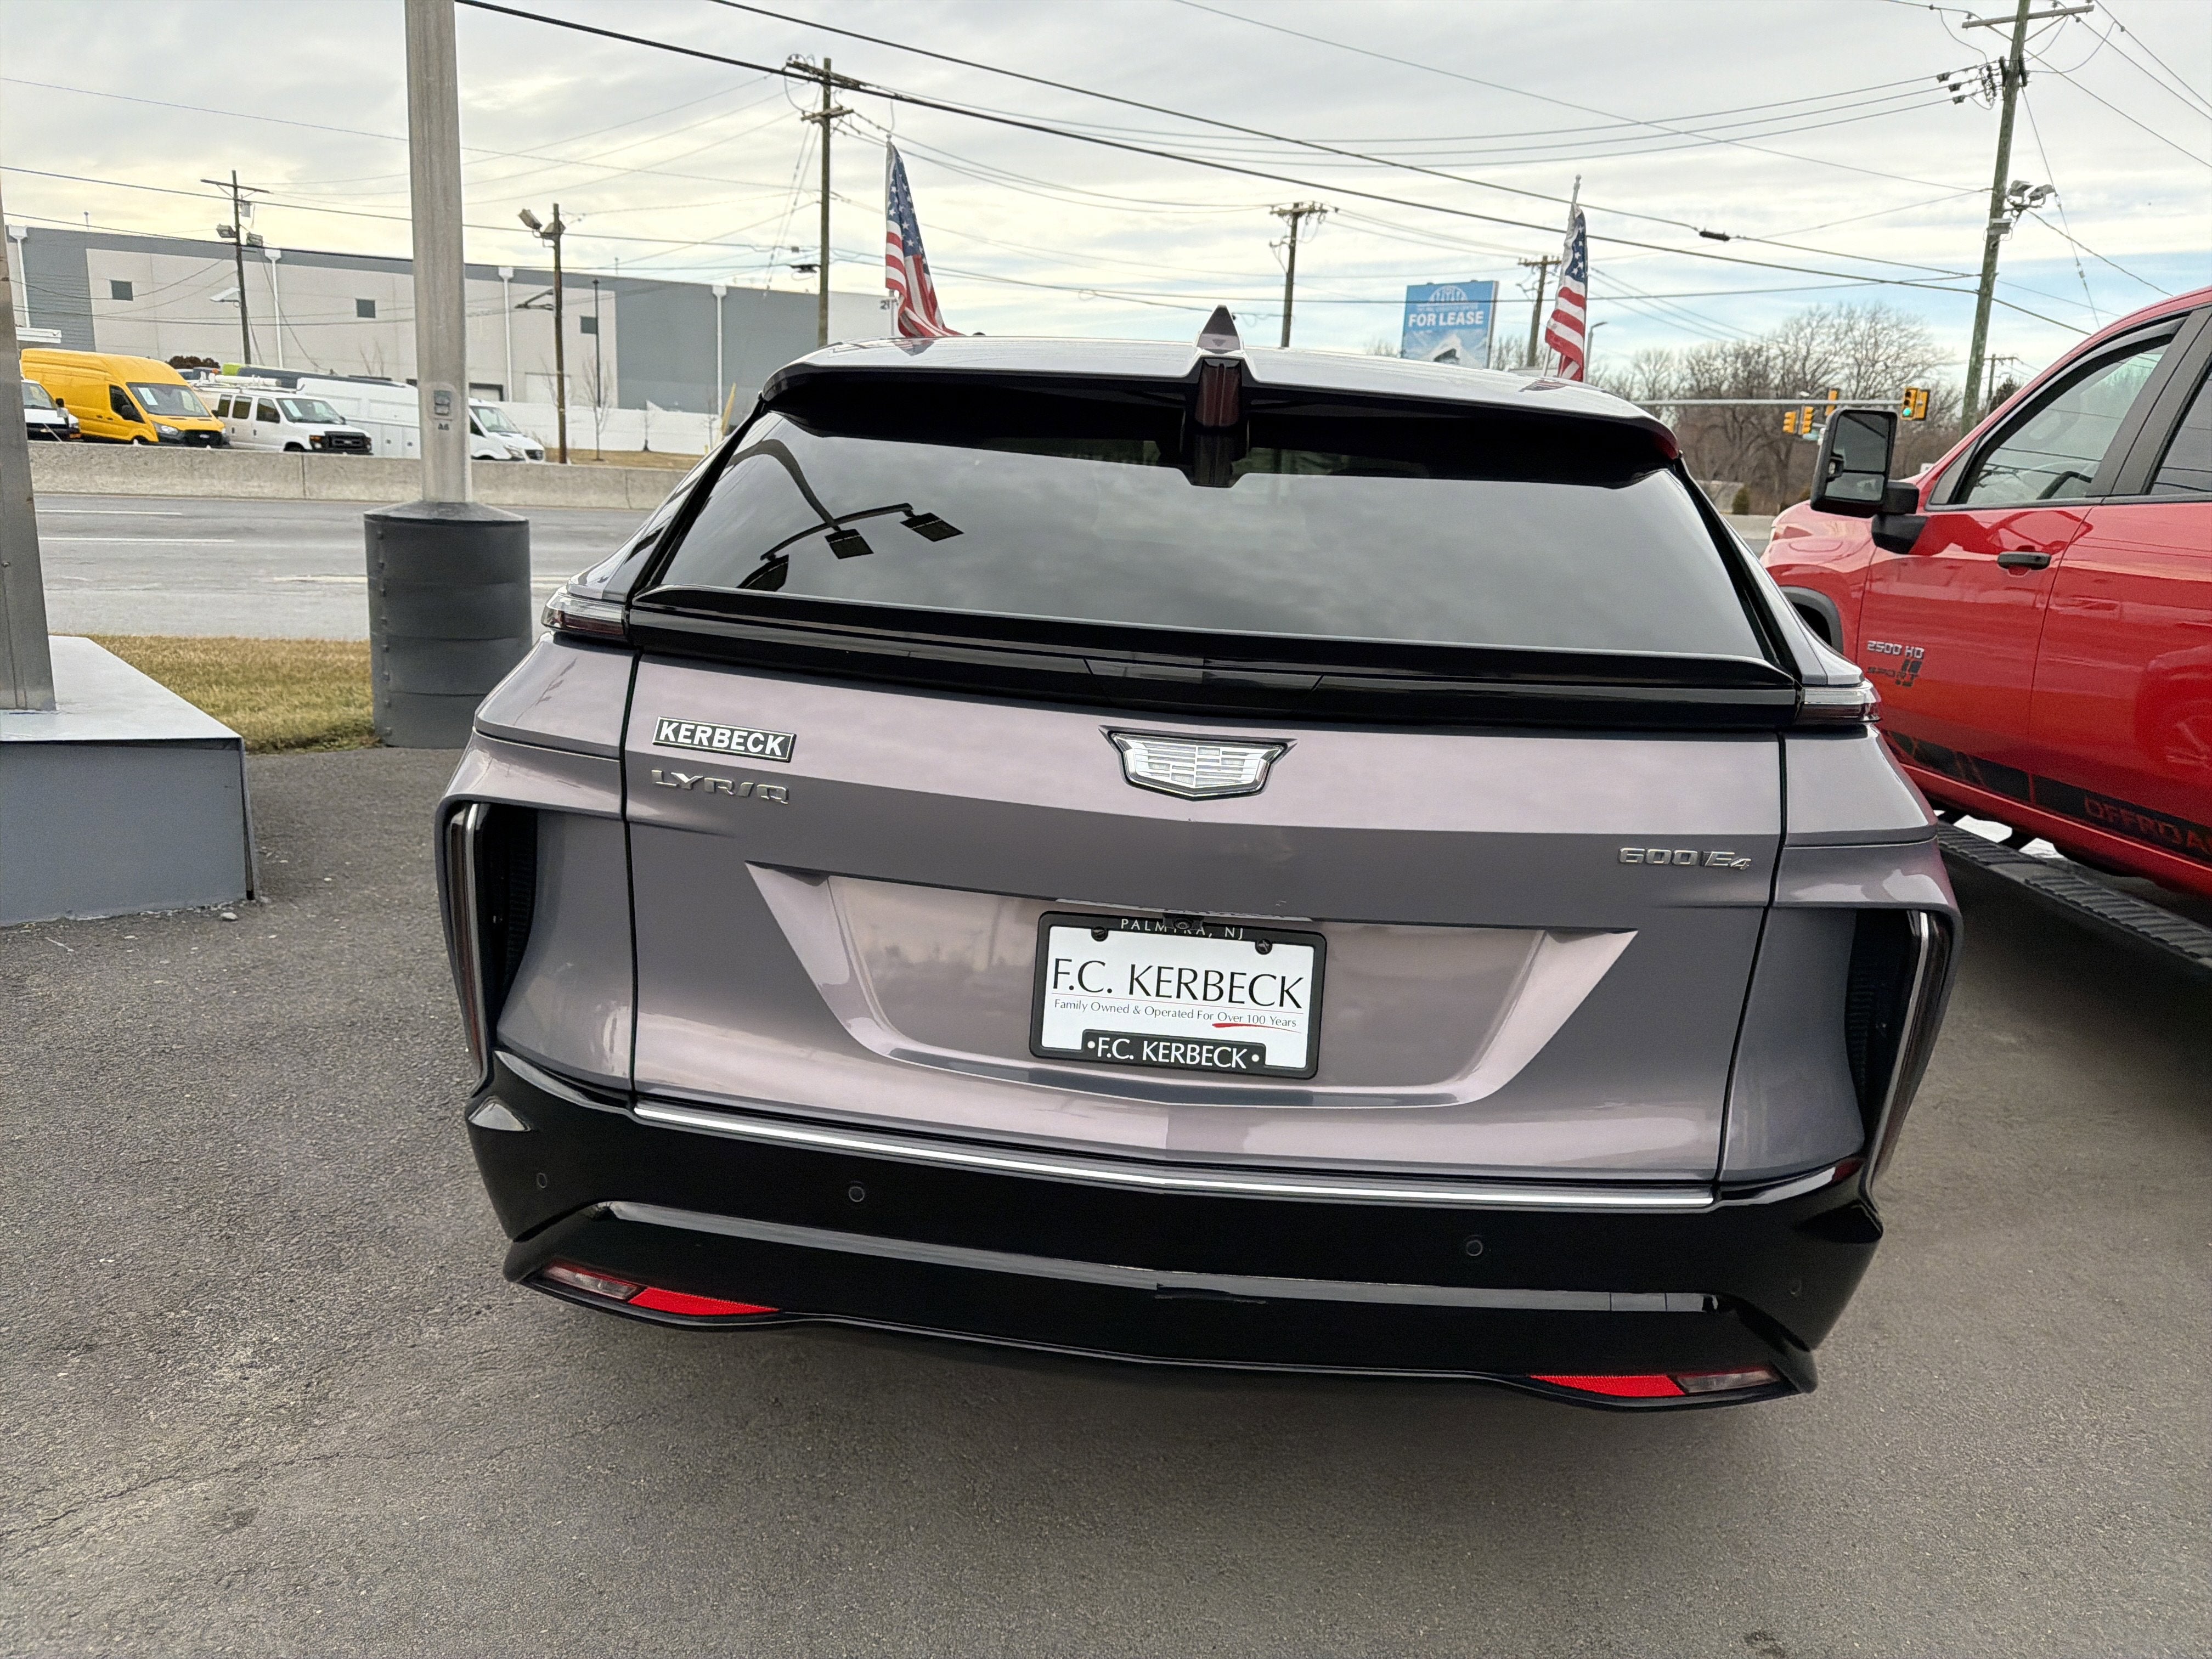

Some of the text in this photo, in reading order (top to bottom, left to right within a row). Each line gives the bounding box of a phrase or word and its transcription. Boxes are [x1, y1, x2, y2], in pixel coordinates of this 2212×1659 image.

[1408, 311, 1484, 327] FOR LEASE
[1867, 640, 1925, 658] 2500 HD
[659, 721, 785, 756] KERBECK
[651, 770, 789, 804] LYRIQ
[2085, 798, 2212, 856] OFFROA
[1619, 848, 1699, 866] 600
[1121, 918, 1243, 940] PALMA, NJ
[1053, 958, 1304, 1009] F.C. KERBECK
[1054, 999, 1297, 1028] Family Owned & Operated For Over 100 Years
[1097, 1037, 1247, 1069] F.C. KERBECK
